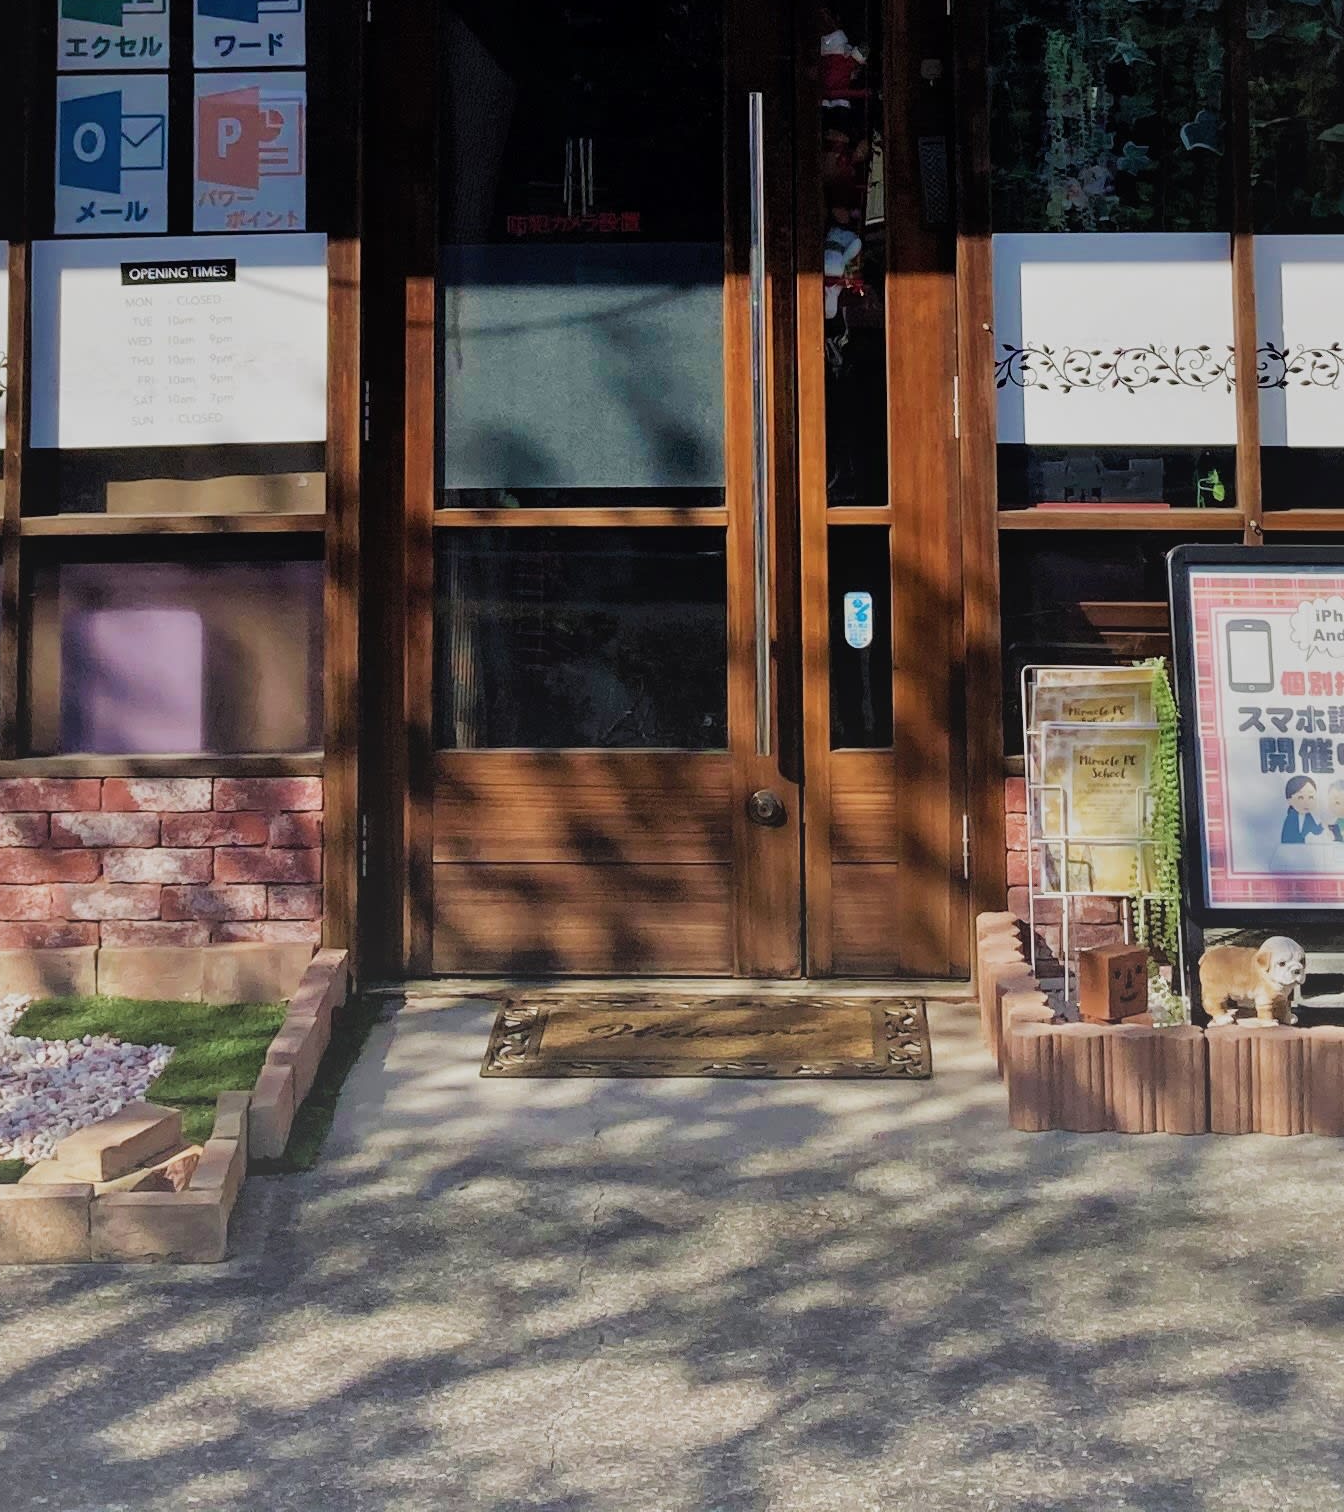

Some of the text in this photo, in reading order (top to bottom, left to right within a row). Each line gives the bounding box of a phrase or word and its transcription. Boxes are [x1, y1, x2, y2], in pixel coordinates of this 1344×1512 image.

[66, 35, 163, 59] エクセル
[214, 33, 286, 57] ワード
[198, 190, 255, 208] パワー
[75, 201, 149, 224] メール
[129, 265, 229, 281] OPENING TIMES
